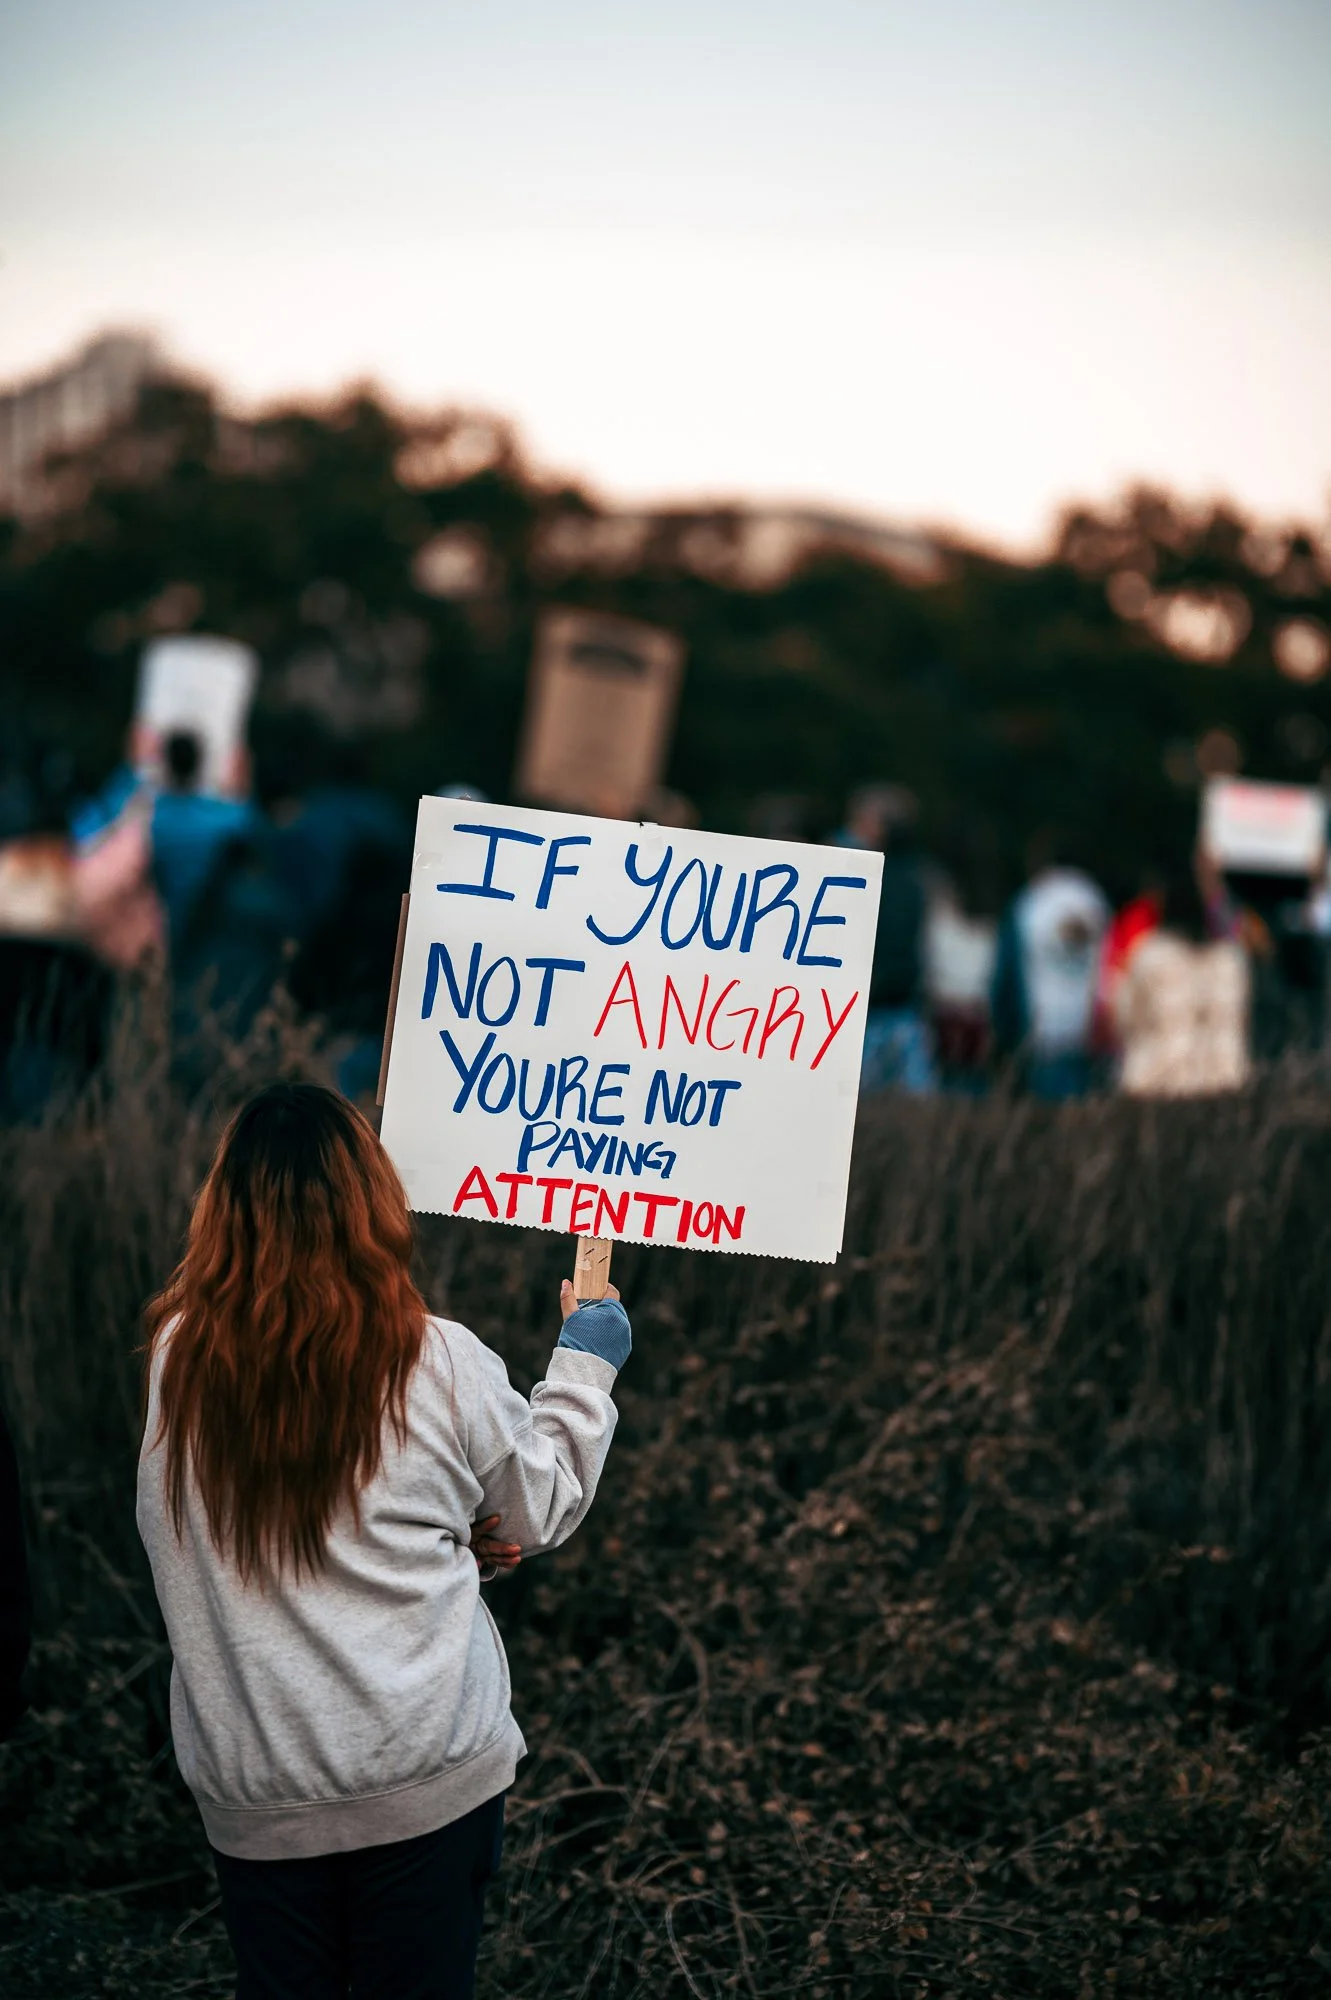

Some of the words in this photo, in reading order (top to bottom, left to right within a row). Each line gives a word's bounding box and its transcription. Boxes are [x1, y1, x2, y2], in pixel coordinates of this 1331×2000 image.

[437, 824, 591, 909] IF
[587, 844, 867, 967] YOURE
[421, 942, 586, 1026] NOT
[594, 961, 859, 1070] ANGRY
[439, 1030, 630, 1126] YOURE
[645, 1070, 742, 1127] NOT
[517, 1121, 676, 1179] PAYING
[454, 1166, 746, 1244] ATTENTION
